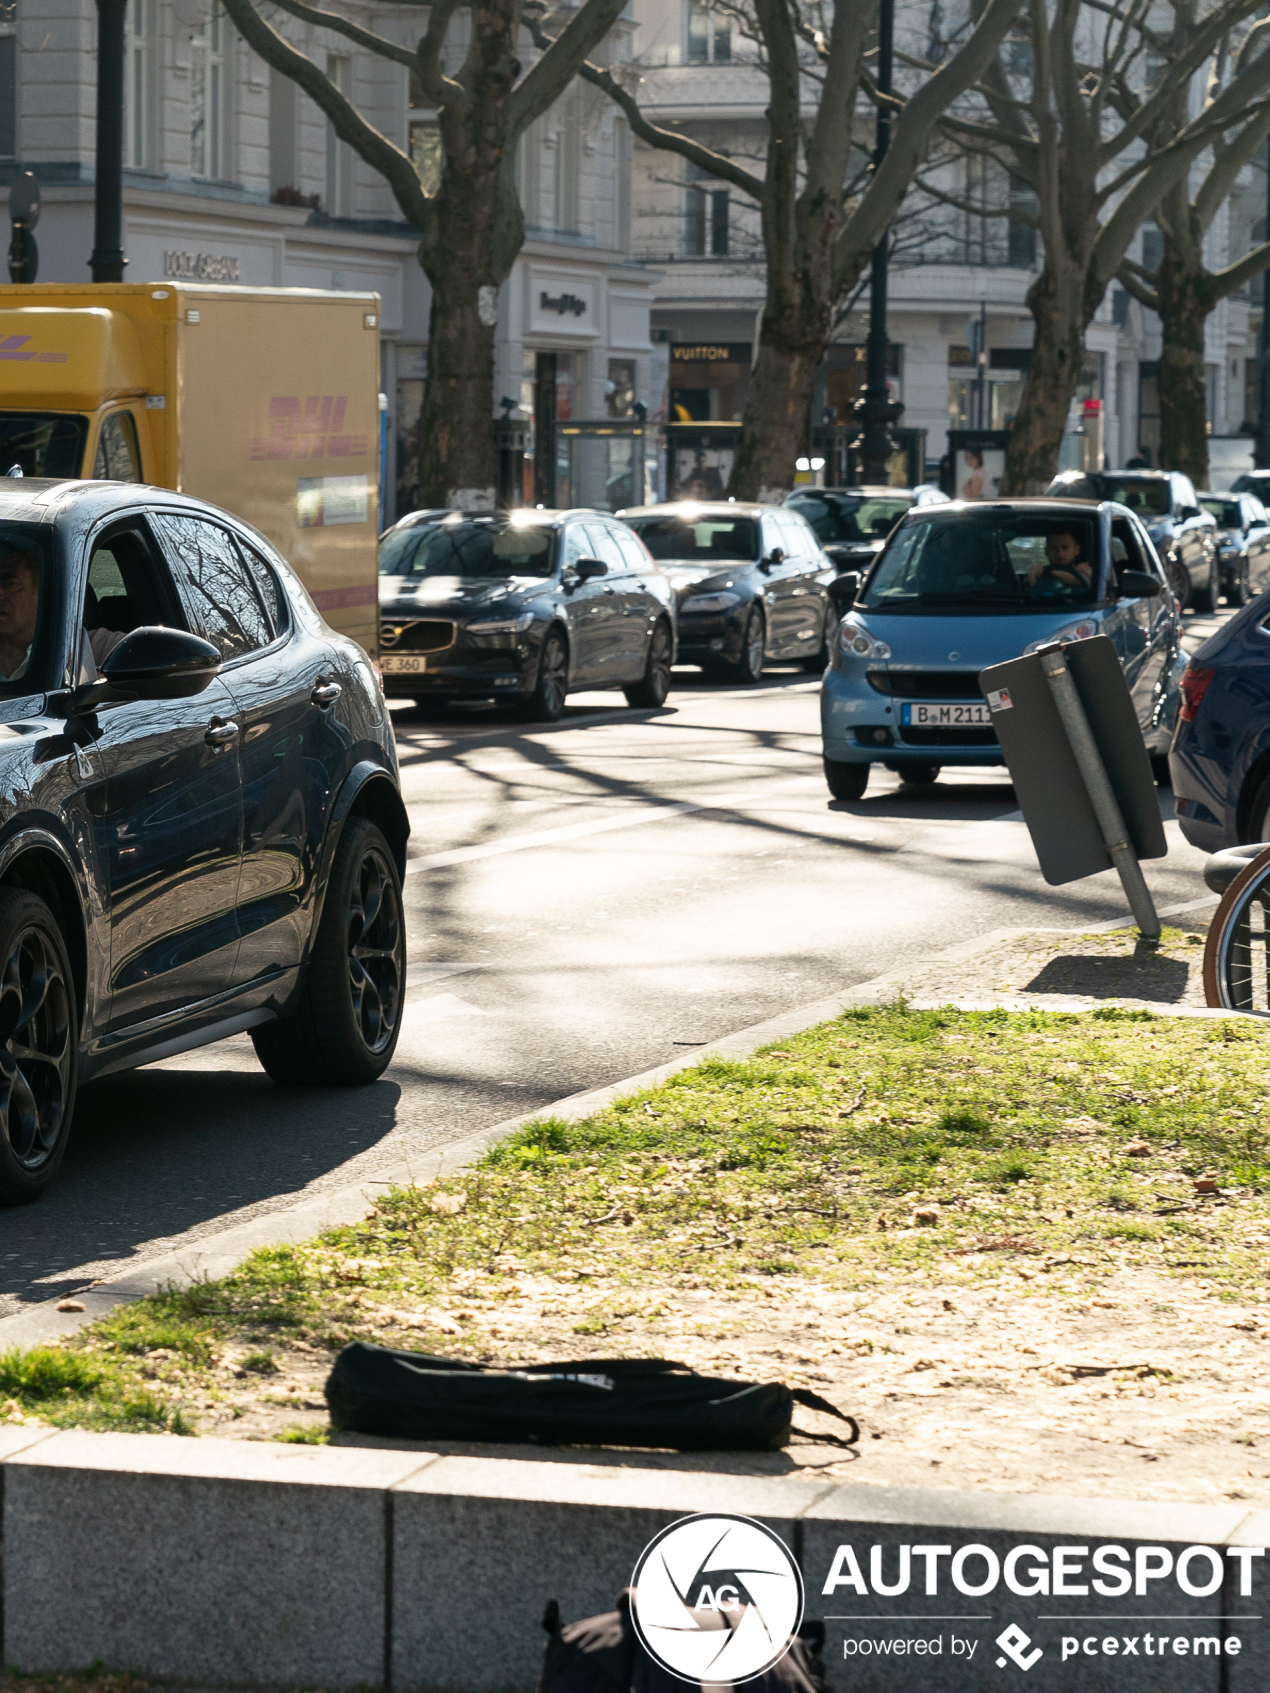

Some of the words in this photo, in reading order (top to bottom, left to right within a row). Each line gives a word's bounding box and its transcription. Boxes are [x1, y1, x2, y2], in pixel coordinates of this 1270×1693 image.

[673, 346, 729, 360] VUITTON
[266, 396, 352, 460] DHL
[918, 707, 928, 723] B
[939, 707, 950, 723] M
